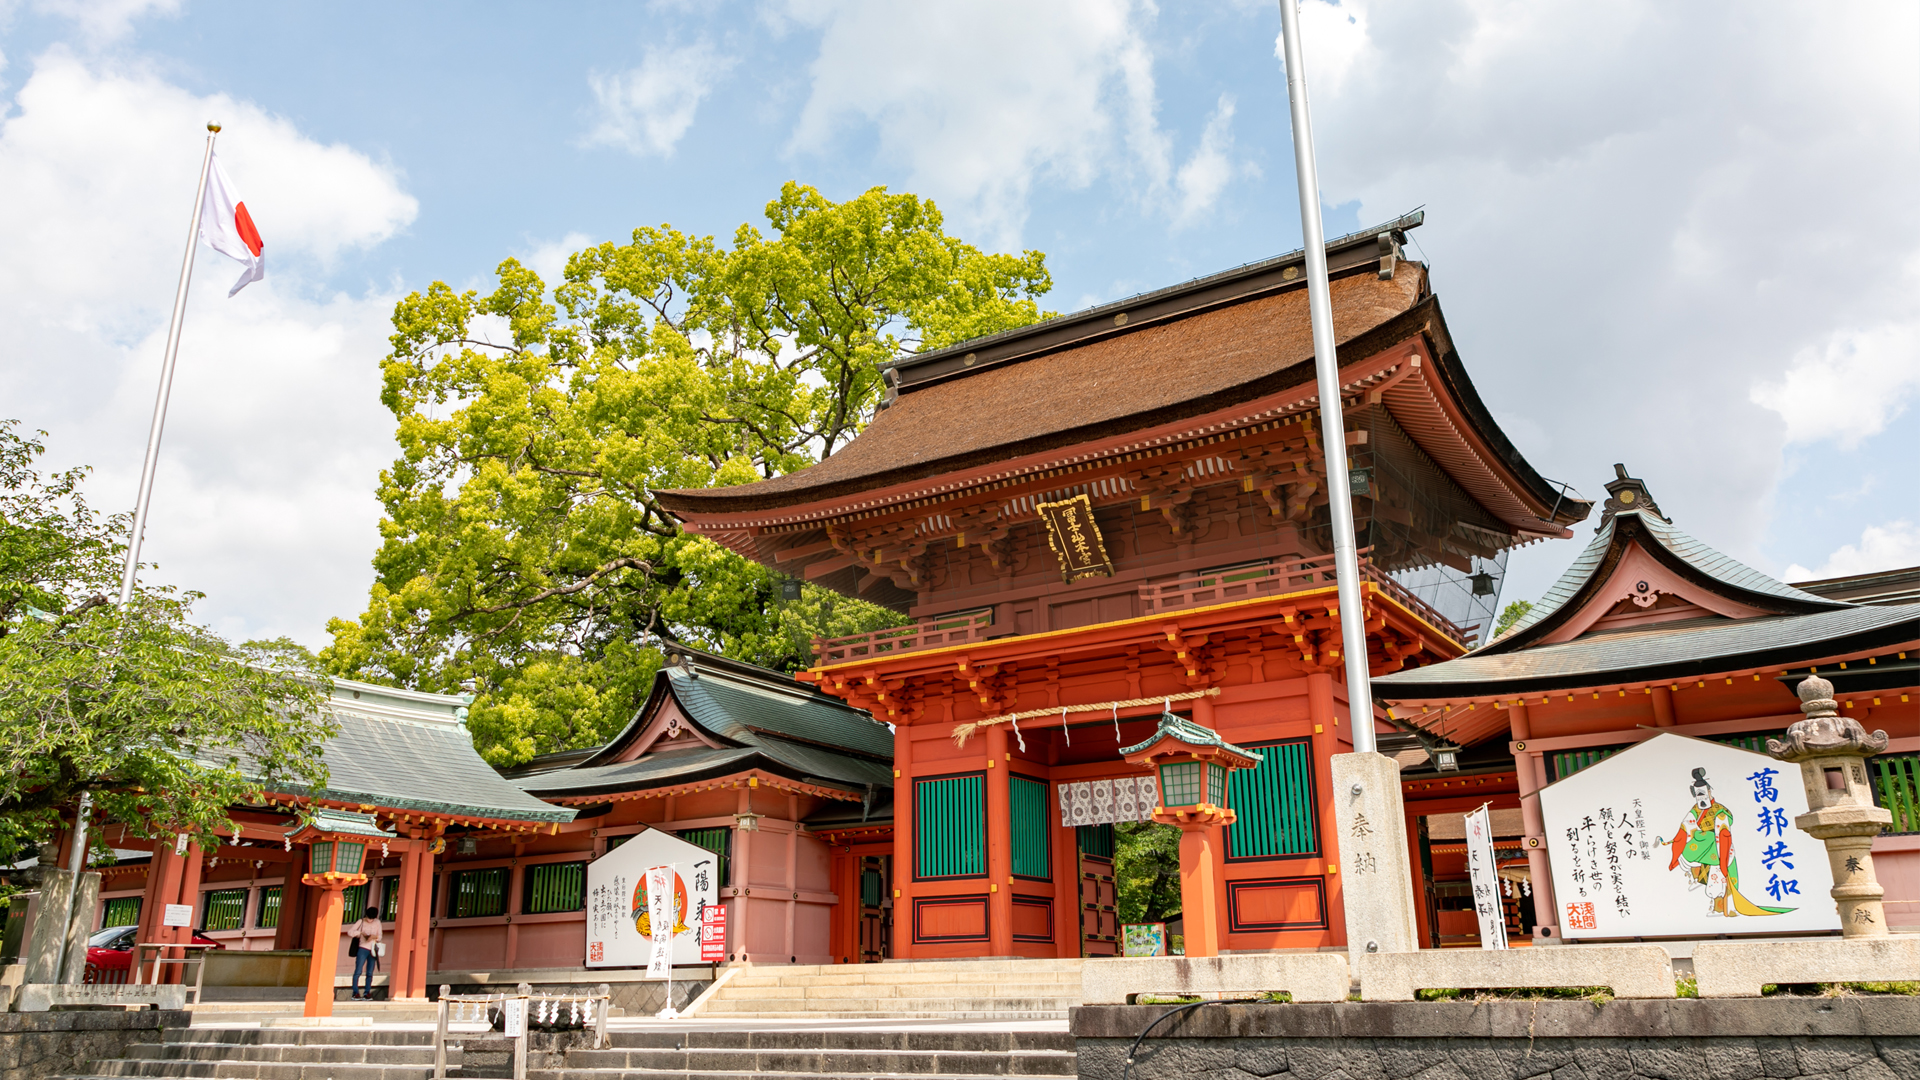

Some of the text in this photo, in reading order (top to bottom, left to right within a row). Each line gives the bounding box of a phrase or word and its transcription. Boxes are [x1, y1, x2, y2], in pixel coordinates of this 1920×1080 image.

[1351, 812, 1377, 875] 奉納
[1566, 827, 1587, 897] 到るを祈る
[1581, 815, 1603, 892] 平らけき世の
[1618, 813, 1637, 859] 人々の
[1632, 798, 1650, 860] 天皇陛下御製
[1746, 767, 1801, 901] 萬邦共和
